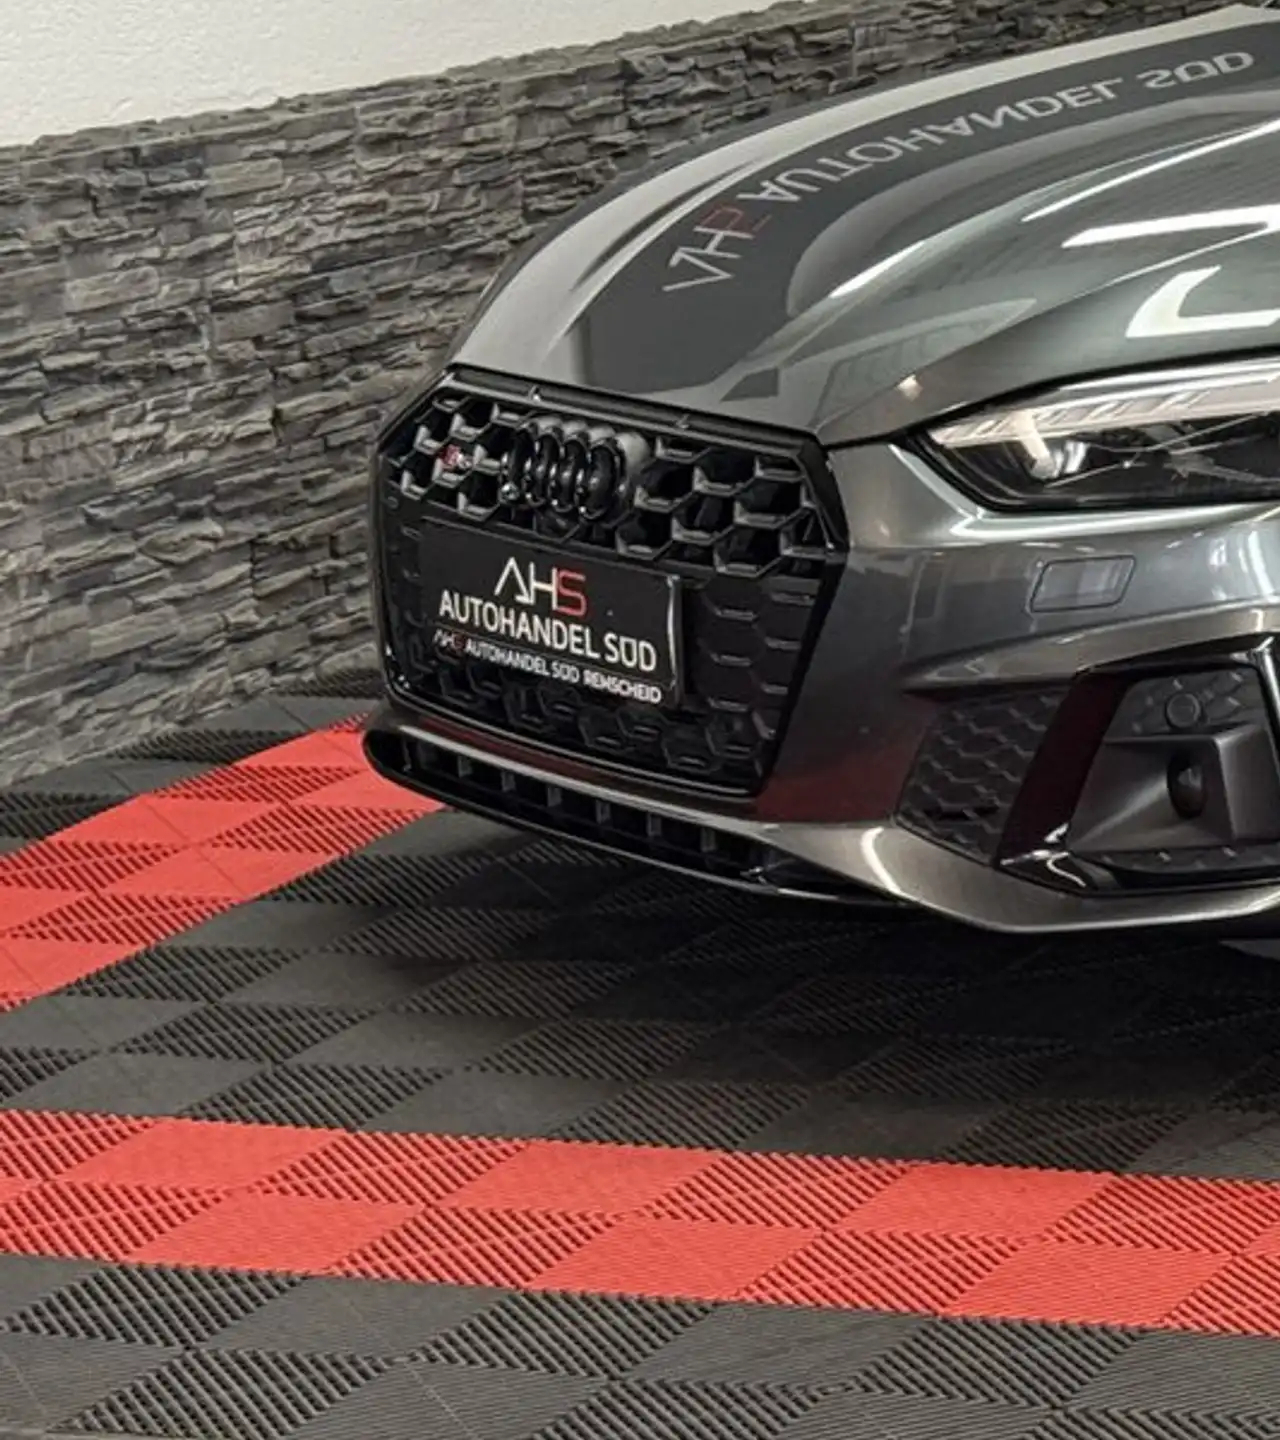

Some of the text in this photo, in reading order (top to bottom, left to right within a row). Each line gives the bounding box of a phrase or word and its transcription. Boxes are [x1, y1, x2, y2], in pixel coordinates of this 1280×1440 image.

[493, 556, 588, 616] AHS
[438, 589, 657, 672] AUTOHANDEL SÜD
[465, 637, 550, 677] AUTOHANDEL
[583, 668, 662, 705] REMSCHEID
